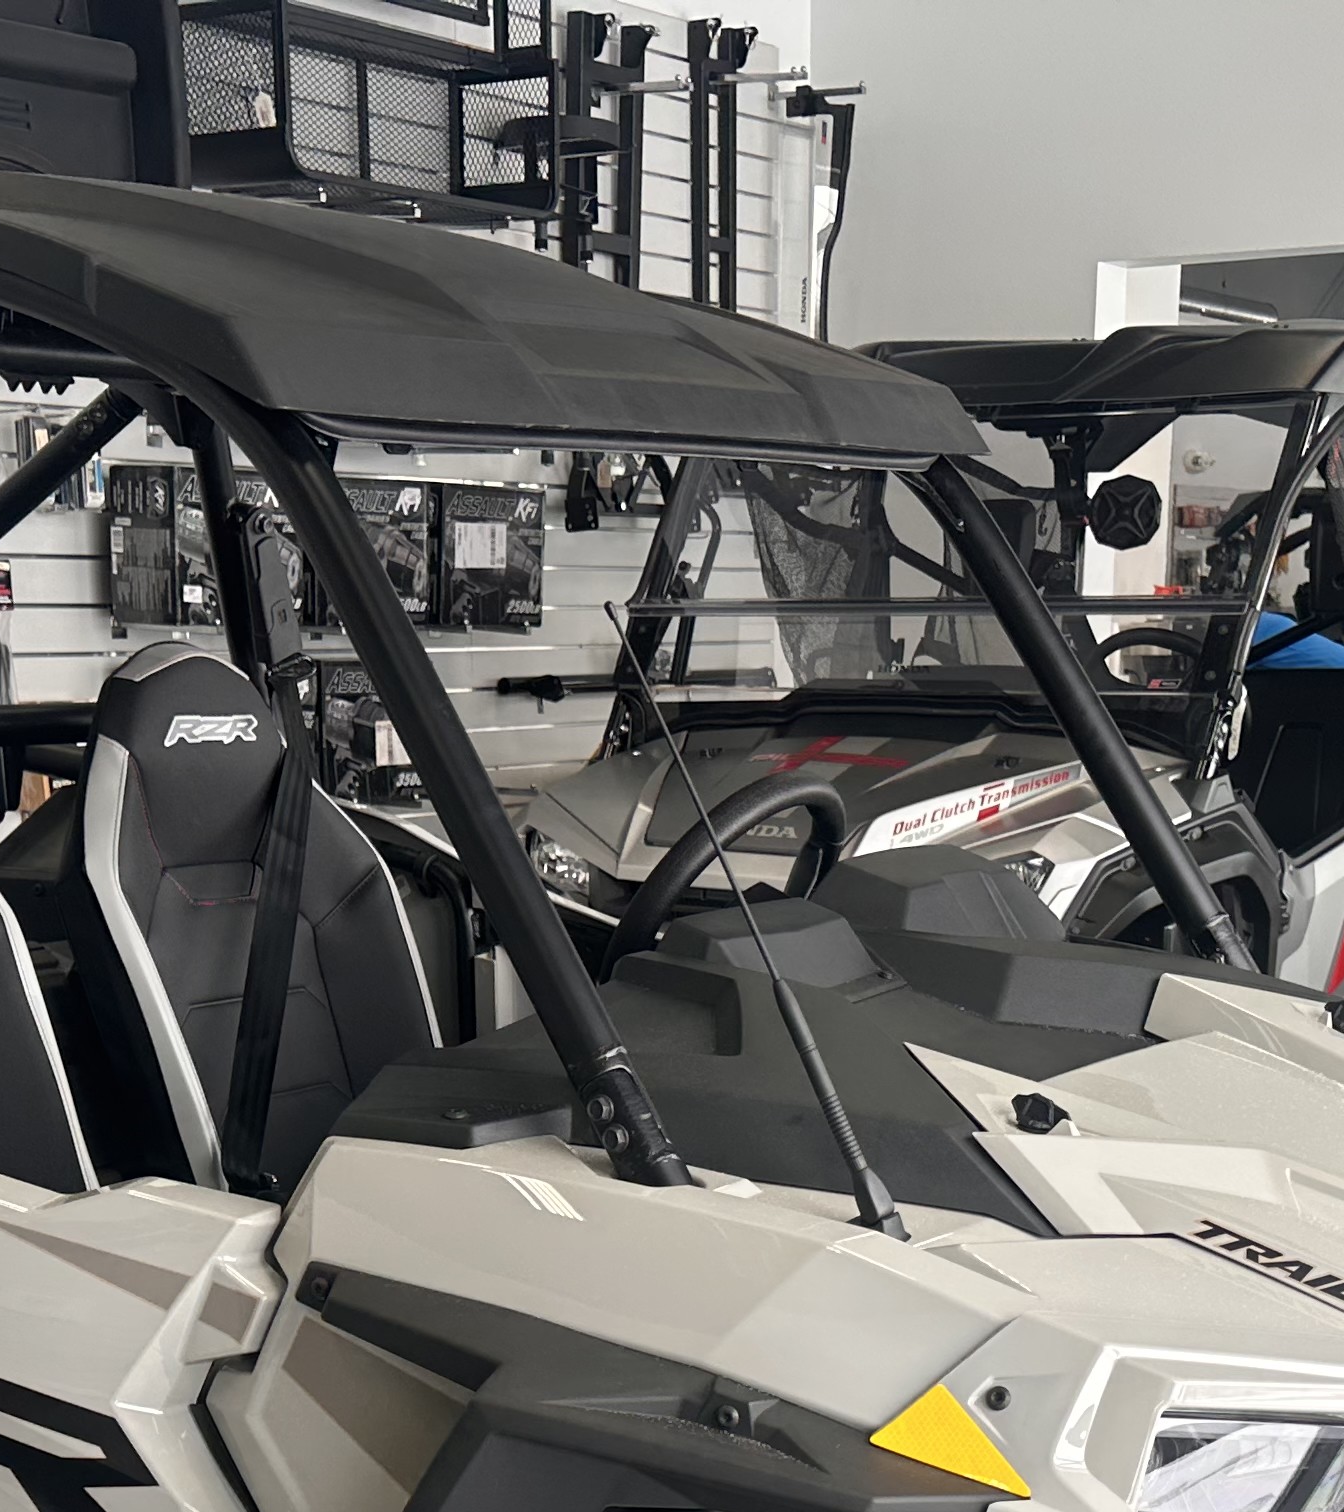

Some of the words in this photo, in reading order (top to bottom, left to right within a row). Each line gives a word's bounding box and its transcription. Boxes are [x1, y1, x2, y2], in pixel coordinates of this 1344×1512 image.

[164, 714, 258, 748] RZR
[892, 812, 928, 837] Dual
[930, 798, 976, 824] Clutch
[979, 769, 1070, 807] Transmission
